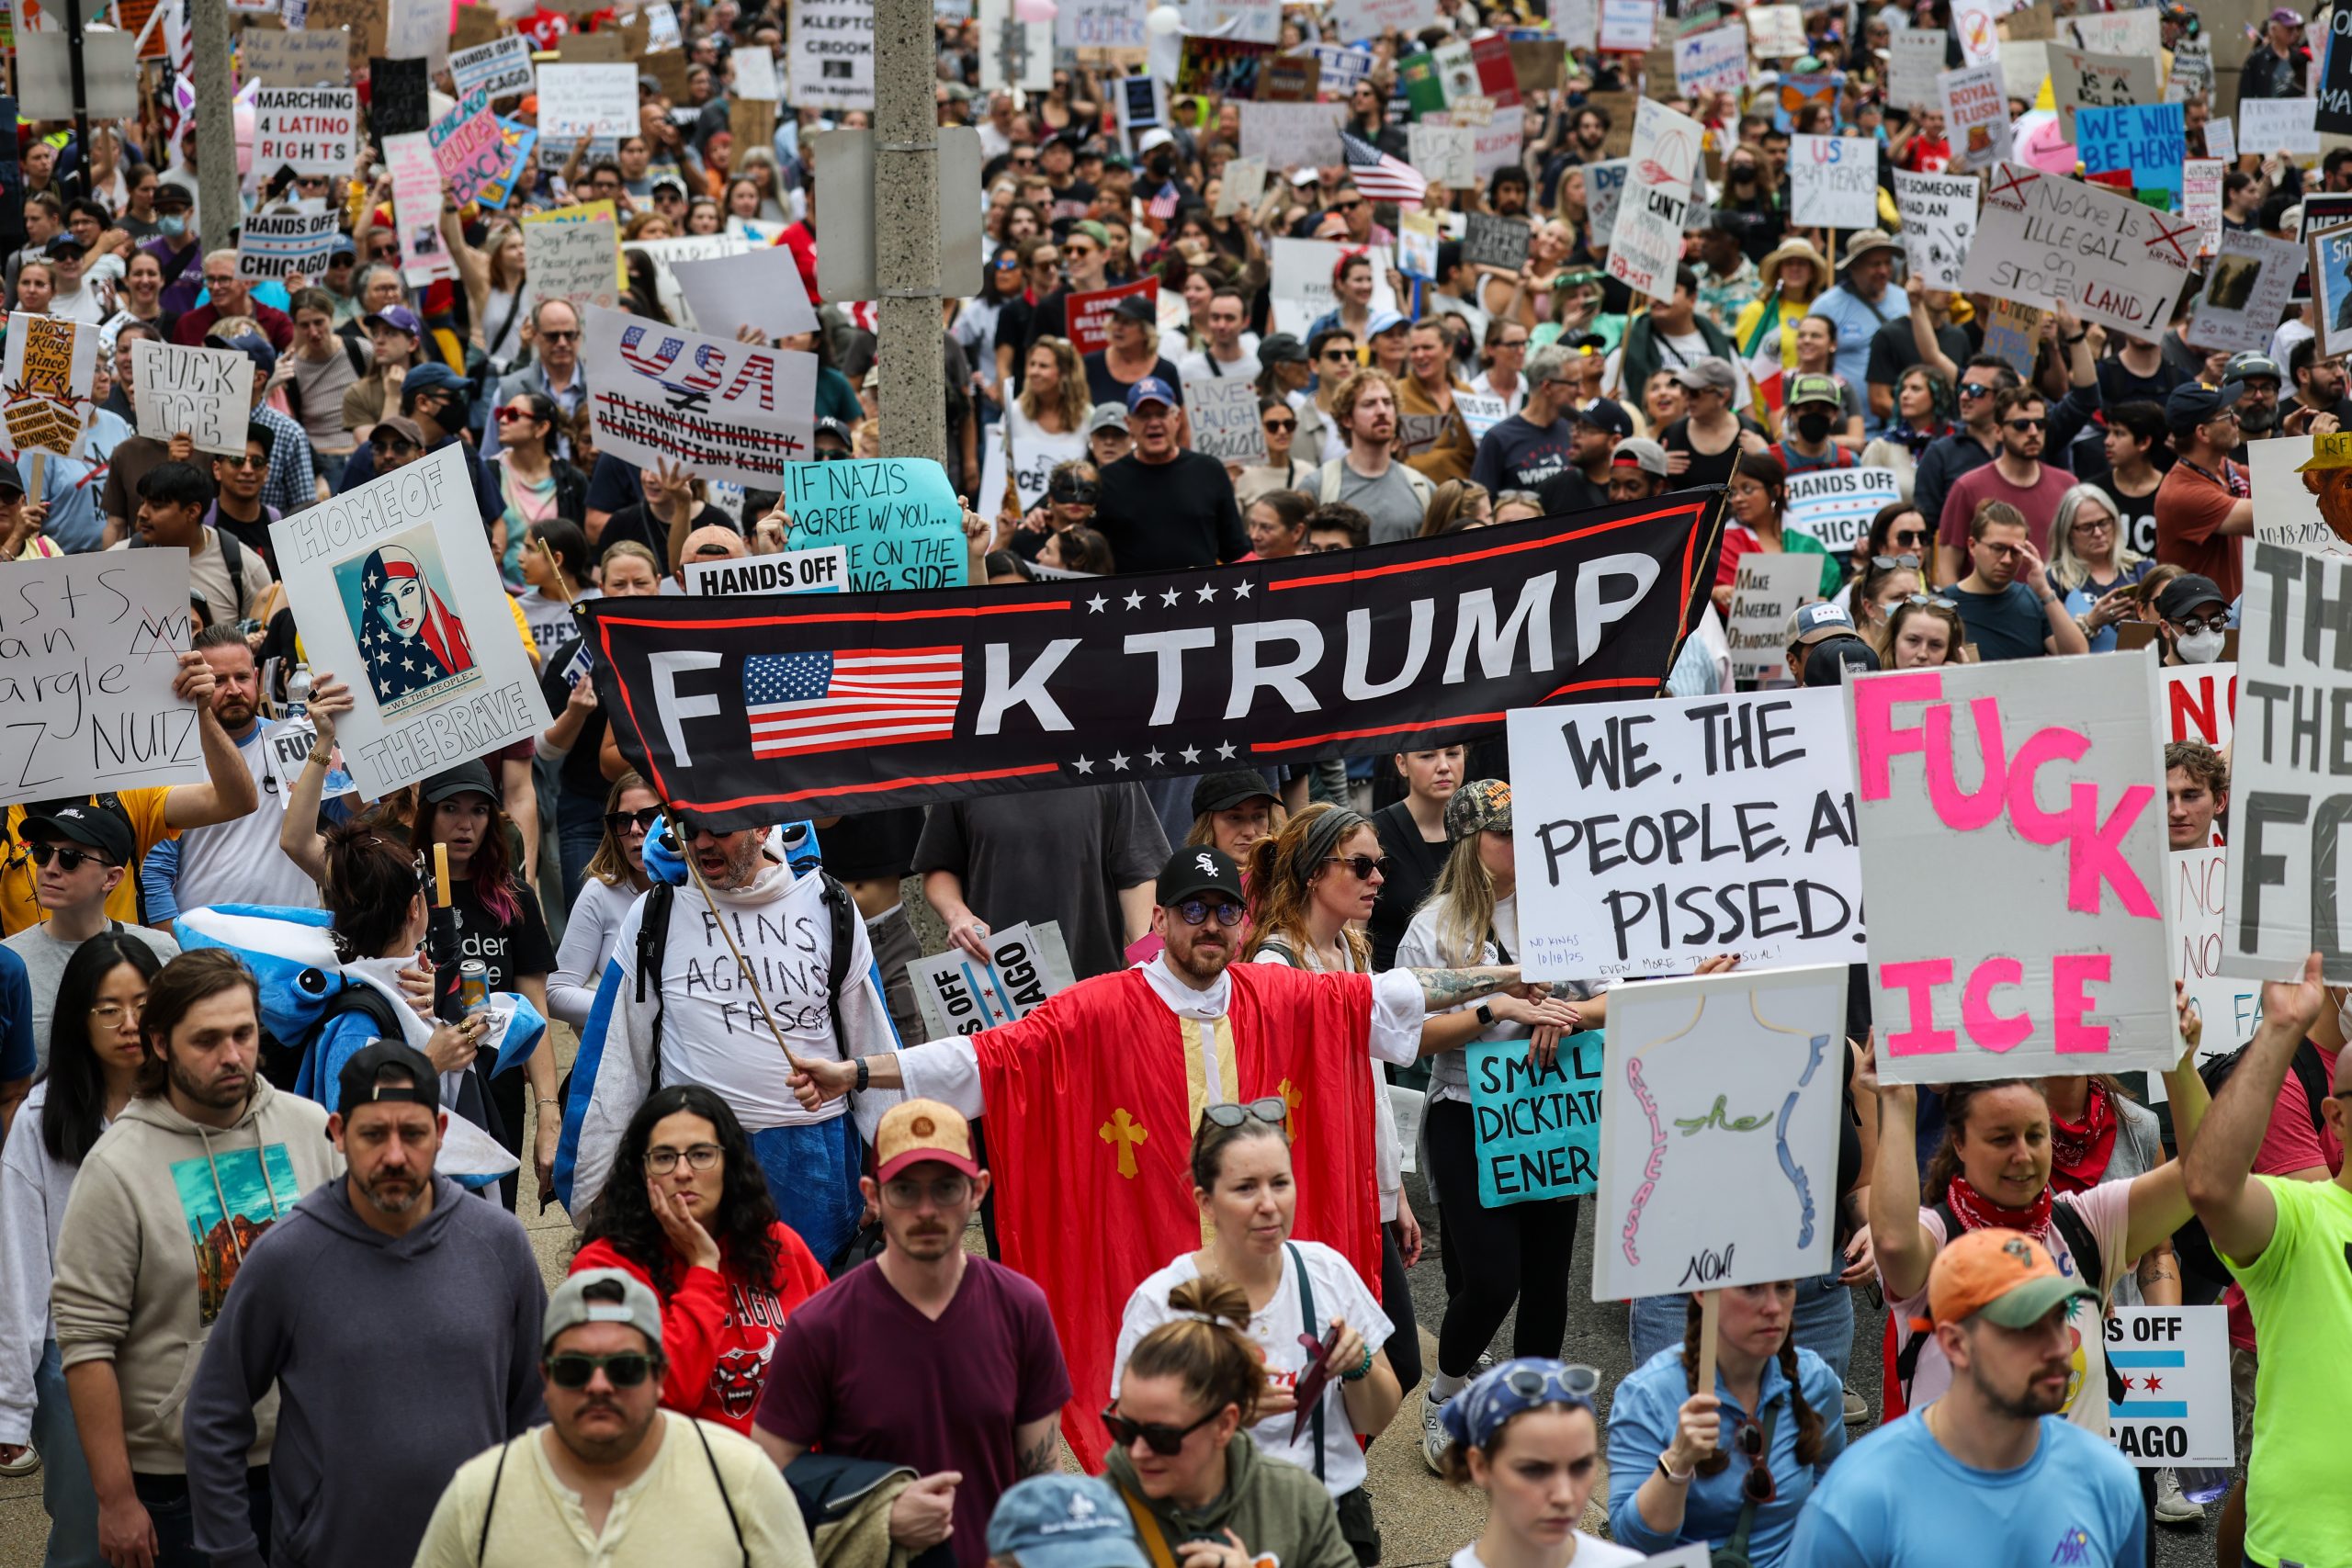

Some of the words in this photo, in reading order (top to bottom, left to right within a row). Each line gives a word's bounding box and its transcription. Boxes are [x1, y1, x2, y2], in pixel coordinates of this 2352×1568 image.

[1949, 81, 1999, 108] ROYAL
[2081, 70, 2101, 89] IS
[2111, 75, 2130, 93] A
[256, 92, 354, 110] MARCHING
[427, 86, 489, 149] CHICAGO
[1952, 100, 2002, 126] FLUSH
[260, 117, 270, 133] 4
[277, 116, 349, 134] LATINO
[2080, 107, 2130, 141] WE
[2138, 102, 2186, 137] WILL
[262, 141, 346, 160] RIGHTS
[435, 109, 498, 174] BITES
[2083, 141, 2120, 175] BE
[450, 139, 514, 207] BACK
[1909, 180, 1973, 199] SOMEONE
[243, 215, 305, 236] HANDS
[308, 210, 335, 231] OFF
[1927, 202, 1949, 218] AN
[2114, 206, 2143, 239] Is
[2022, 215, 2129, 267] ILLEGAL
[240, 251, 329, 276] CHICAGO
[1989, 260, 2086, 305] STOLEN
[29, 321, 53, 335] No
[25, 350, 71, 370] Since
[26, 334, 73, 356] Kings
[141, 344, 238, 396] FUCK
[619, 324, 775, 412] USA
[1192, 380, 1248, 406] LIVE
[1480, 400, 1502, 414] OFF
[5, 408, 17, 421] NO
[16, 400, 51, 417] THRONES
[8, 423, 20, 434] NO
[20, 413, 54, 431] CROWNS
[148, 391, 222, 447] ICE
[606, 390, 685, 435] PLENARY
[1189, 404, 1259, 432] LAUGH
[13, 435, 29, 450] NO
[28, 426, 61, 446] KINGS
[688, 416, 797, 457] AUTHORITY
[1196, 426, 1265, 457] Resist
[734, 450, 786, 477] KING
[792, 463, 821, 503] IF
[827, 461, 909, 502] NAZIS
[1016, 470, 1046, 493] CE
[1787, 472, 1858, 500] HANDS
[1862, 471, 1894, 491] OFF
[289, 484, 400, 563] HOME
[398, 459, 445, 518] OF
[787, 502, 862, 537] AGREE
[1813, 519, 1872, 545] HICA
[873, 540, 905, 566] ON
[910, 536, 956, 565] THE
[699, 559, 794, 596] HANDS
[798, 555, 838, 585] OFF
[900, 563, 959, 592] SIDE
[1123, 551, 1662, 728] TRUMP
[391, 696, 411, 710] WE
[409, 687, 431, 705] THE
[430, 671, 469, 694] PEOPLE
[92, 707, 201, 772] NUTZ
[358, 719, 439, 788] THE
[425, 680, 537, 762] BRAVE
[1683, 699, 1807, 777] THE
[1852, 672, 2164, 921] FUCK
[702, 909, 817, 953] FINS
[1548, 934, 1579, 947] KINGS
[686, 953, 828, 999] AGAINS
[1600, 962, 1632, 976] EVEN
[1642, 955, 1677, 970] MORE
[1686, 953, 1712, 967] THA
[1742, 944, 1783, 963] SUAL!
[933, 969, 974, 1017] OFF
[1880, 954, 2112, 1058] ICE
[1479, 1039, 1605, 1095] SMAL
[1622, 1056, 1669, 1268] RELEASE
[1678, 1243, 1736, 1287] NOW!
[2132, 1316, 2182, 1342] OFF
